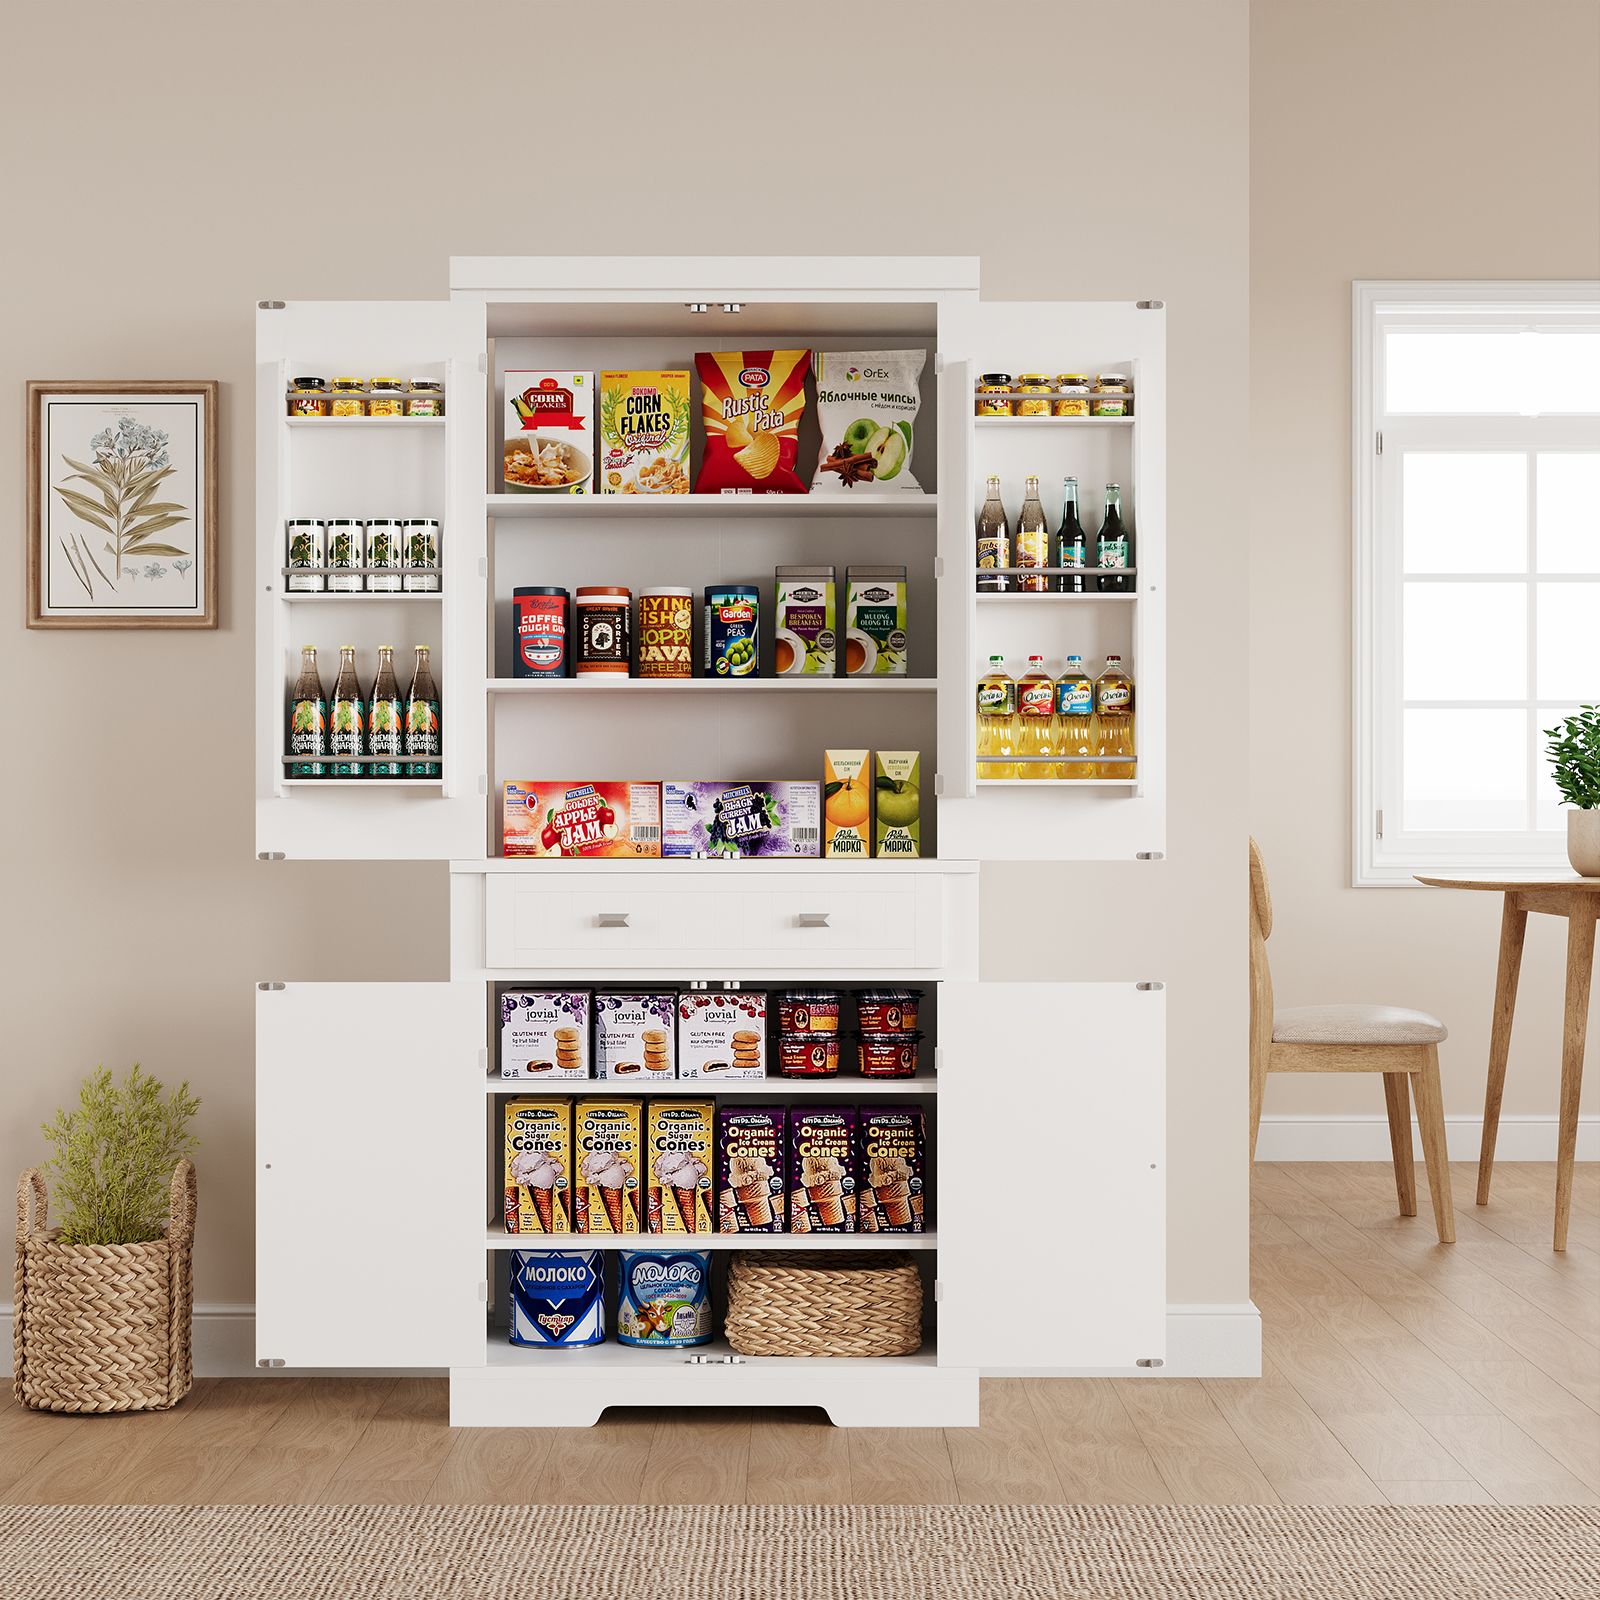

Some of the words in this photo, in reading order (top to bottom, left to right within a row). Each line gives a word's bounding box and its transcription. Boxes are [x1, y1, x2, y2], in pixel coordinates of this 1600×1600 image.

[864, 369, 889, 378] OrEx
[530, 394, 564, 402] CORN
[819, 391, 877, 402] Яблочные
[881, 392, 916, 404] чипсы
[626, 394, 661, 415] CORN
[722, 392, 769, 419] Rustic
[620, 413, 670, 435] FLAKES
[754, 409, 784, 432] Pata
[625, 430, 666, 446] Original
[522, 614, 563, 624] COFFEE
[722, 610, 751, 619] Garden
[518, 624, 550, 634] TOUGH
[639, 646, 691, 662] JAVA
[566, 795, 599, 811] GOLDEN
[724, 796, 753, 811] BLACK
[555, 806, 597, 828] APPLE
[720, 807, 751, 820] CURRENT
[727, 813, 762, 836] JAM
[563, 820, 602, 846] JAM
[833, 840, 861, 852] МАРКА
[885, 840, 912, 852] МАРКА
[525, 1008, 558, 1022] jovial
[613, 1010, 646, 1024] jovial
[704, 1009, 736, 1022] jovial
[514, 1120, 560, 1132] Organic
[584, 1120, 631, 1132] Organic
[657, 1121, 704, 1132] Organic
[801, 1126, 847, 1139] Organic
[525, 1132, 549, 1140] Sugar
[595, 1132, 619, 1140] Sugar
[668, 1132, 692, 1140] Sugar
[728, 1127, 774, 1139] Organic
[869, 1127, 914, 1139] Organic
[512, 1137, 562, 1150] Cones
[582, 1137, 632, 1150] Cones
[655, 1137, 705, 1151] Cones
[727, 1143, 776, 1157] Cones
[799, 1143, 848, 1157] Cones
[867, 1143, 915, 1157] Cones
[526, 1266, 586, 1282] МОЛОКО
